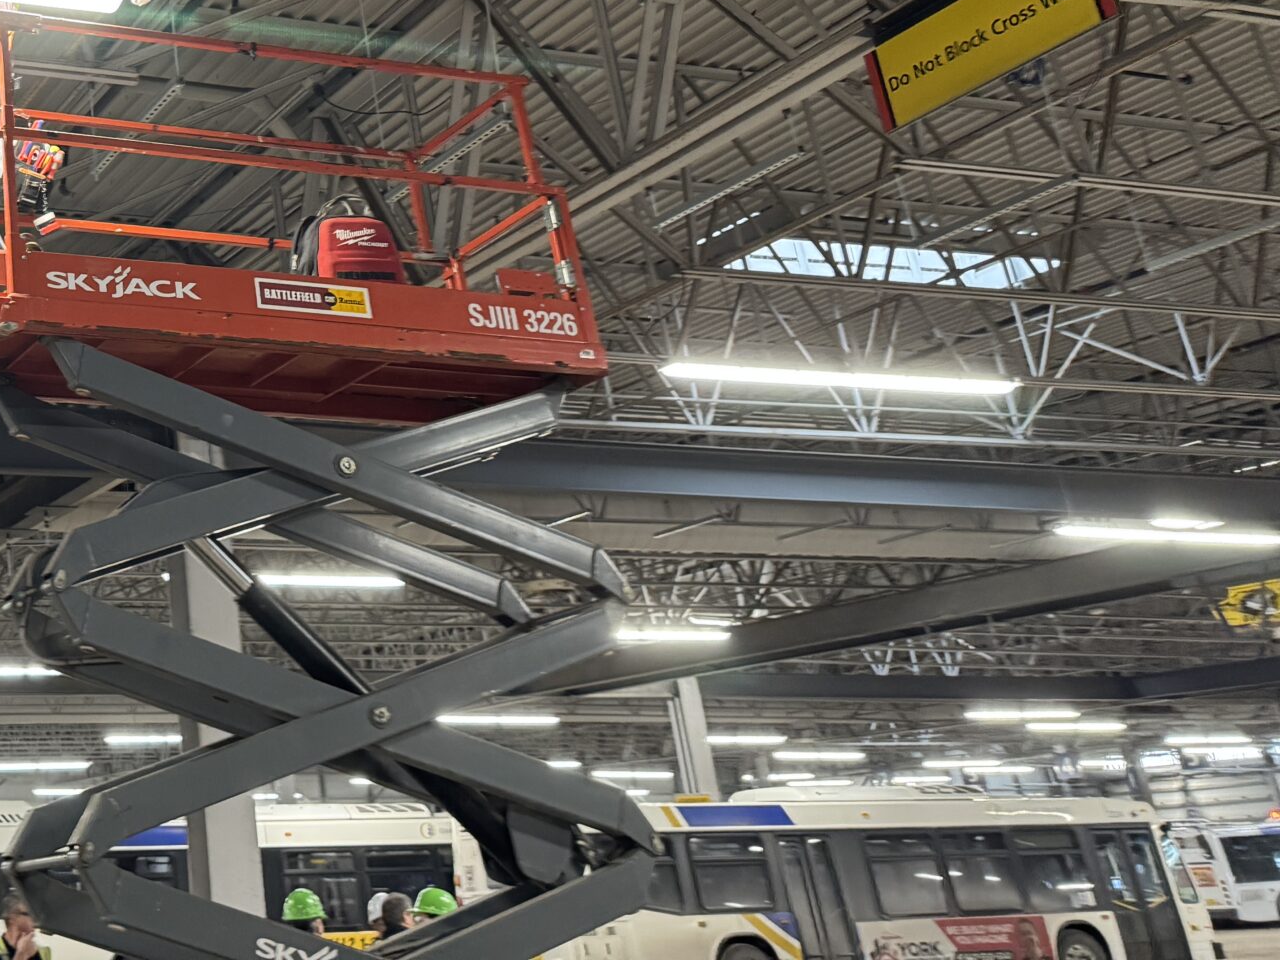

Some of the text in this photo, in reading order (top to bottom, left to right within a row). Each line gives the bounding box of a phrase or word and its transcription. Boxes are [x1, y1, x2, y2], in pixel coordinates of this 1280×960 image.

[888, 72, 910, 92] Do
[912, 54, 944, 80] Not
[944, 28, 991, 62] Block
[991, 2, 1038, 36] Cross
[332, 227, 376, 241] Milwaukee
[263, 288, 322, 304] BATTLEFIELD
[467, 302, 578, 337] SJIII 3226
